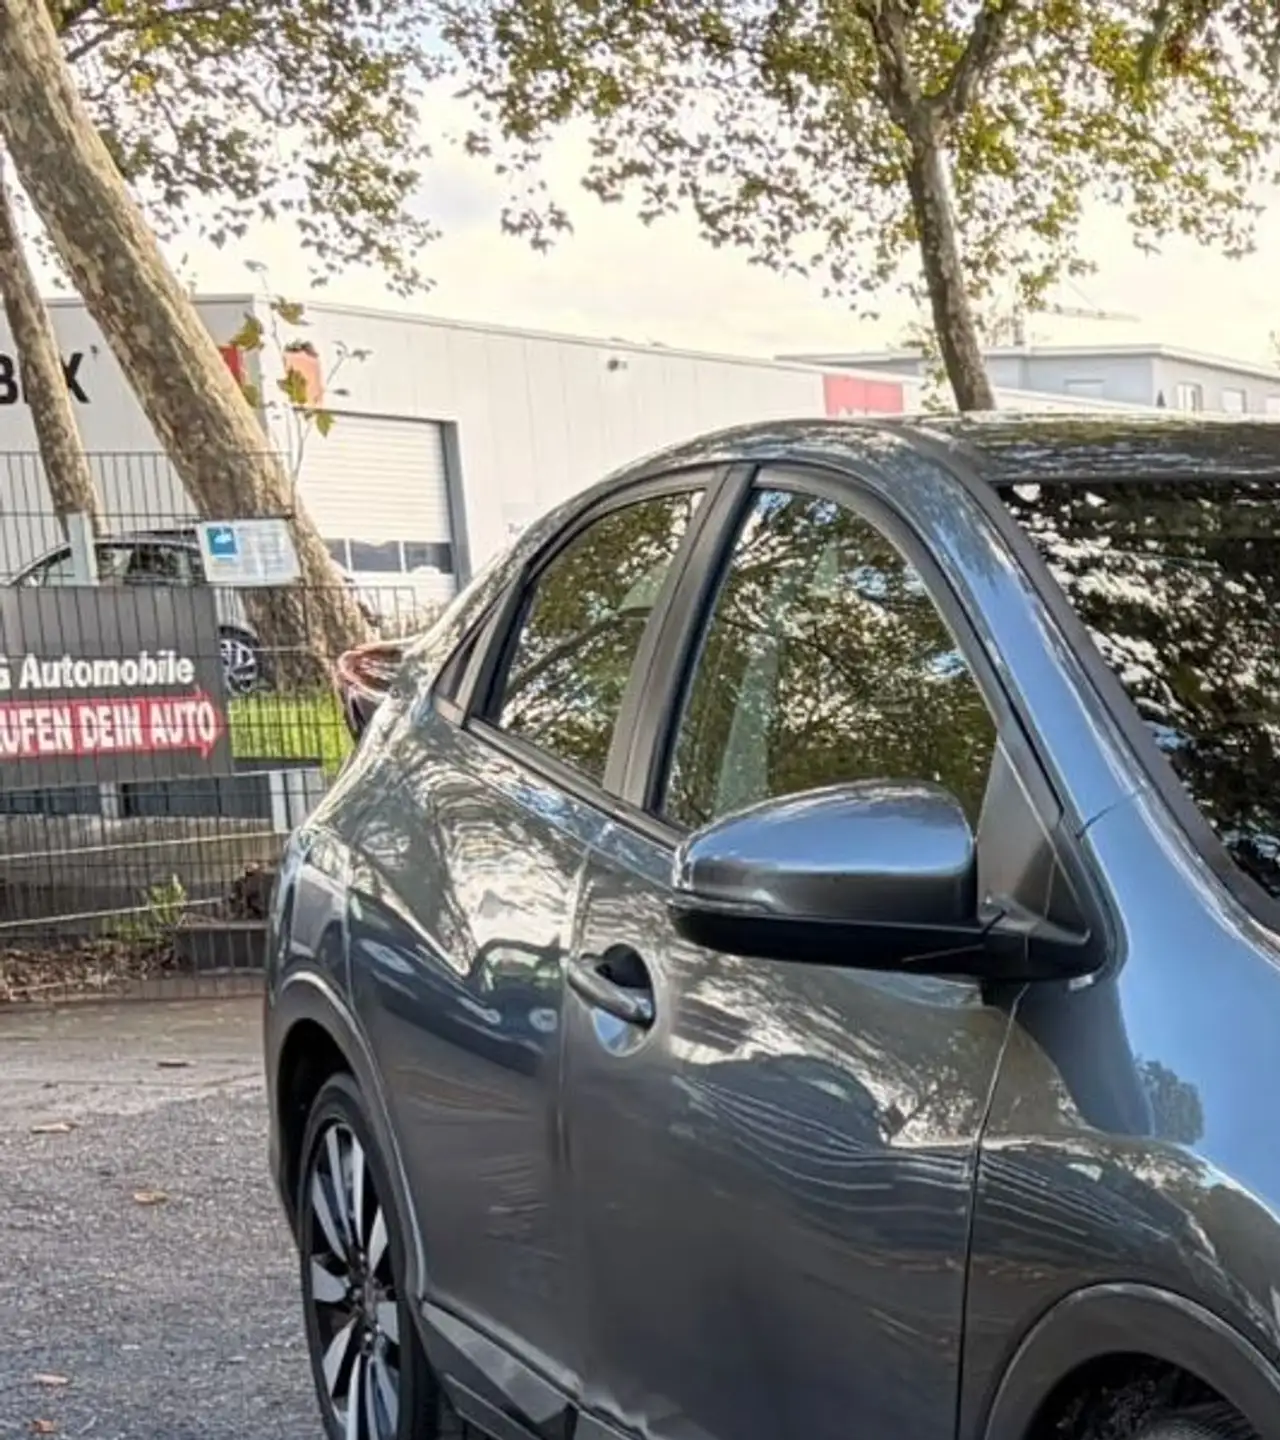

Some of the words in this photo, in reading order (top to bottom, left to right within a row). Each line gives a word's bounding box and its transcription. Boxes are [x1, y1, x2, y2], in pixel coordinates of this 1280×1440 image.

[0, 353, 91, 404] BX
[19, 650, 194, 689] Automobile
[78, 703, 143, 748] DEIN
[151, 700, 215, 745] AUTO
